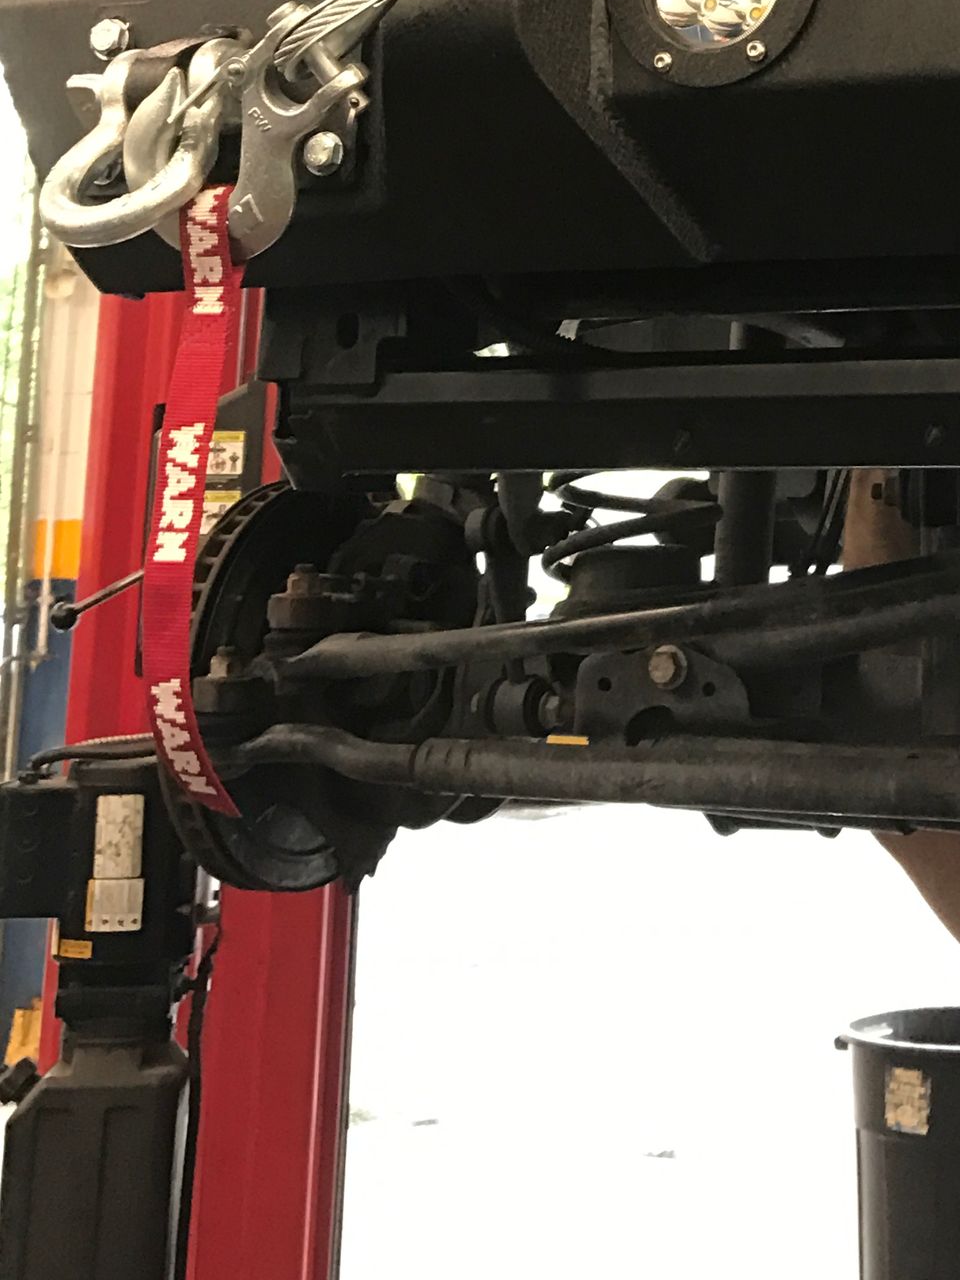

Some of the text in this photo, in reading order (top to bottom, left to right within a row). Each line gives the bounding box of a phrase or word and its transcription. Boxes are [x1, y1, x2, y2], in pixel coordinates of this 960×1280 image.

[186, 186, 227, 315] WARN
[153, 422, 206, 562] WARN
[151, 678, 218, 795] WARN
